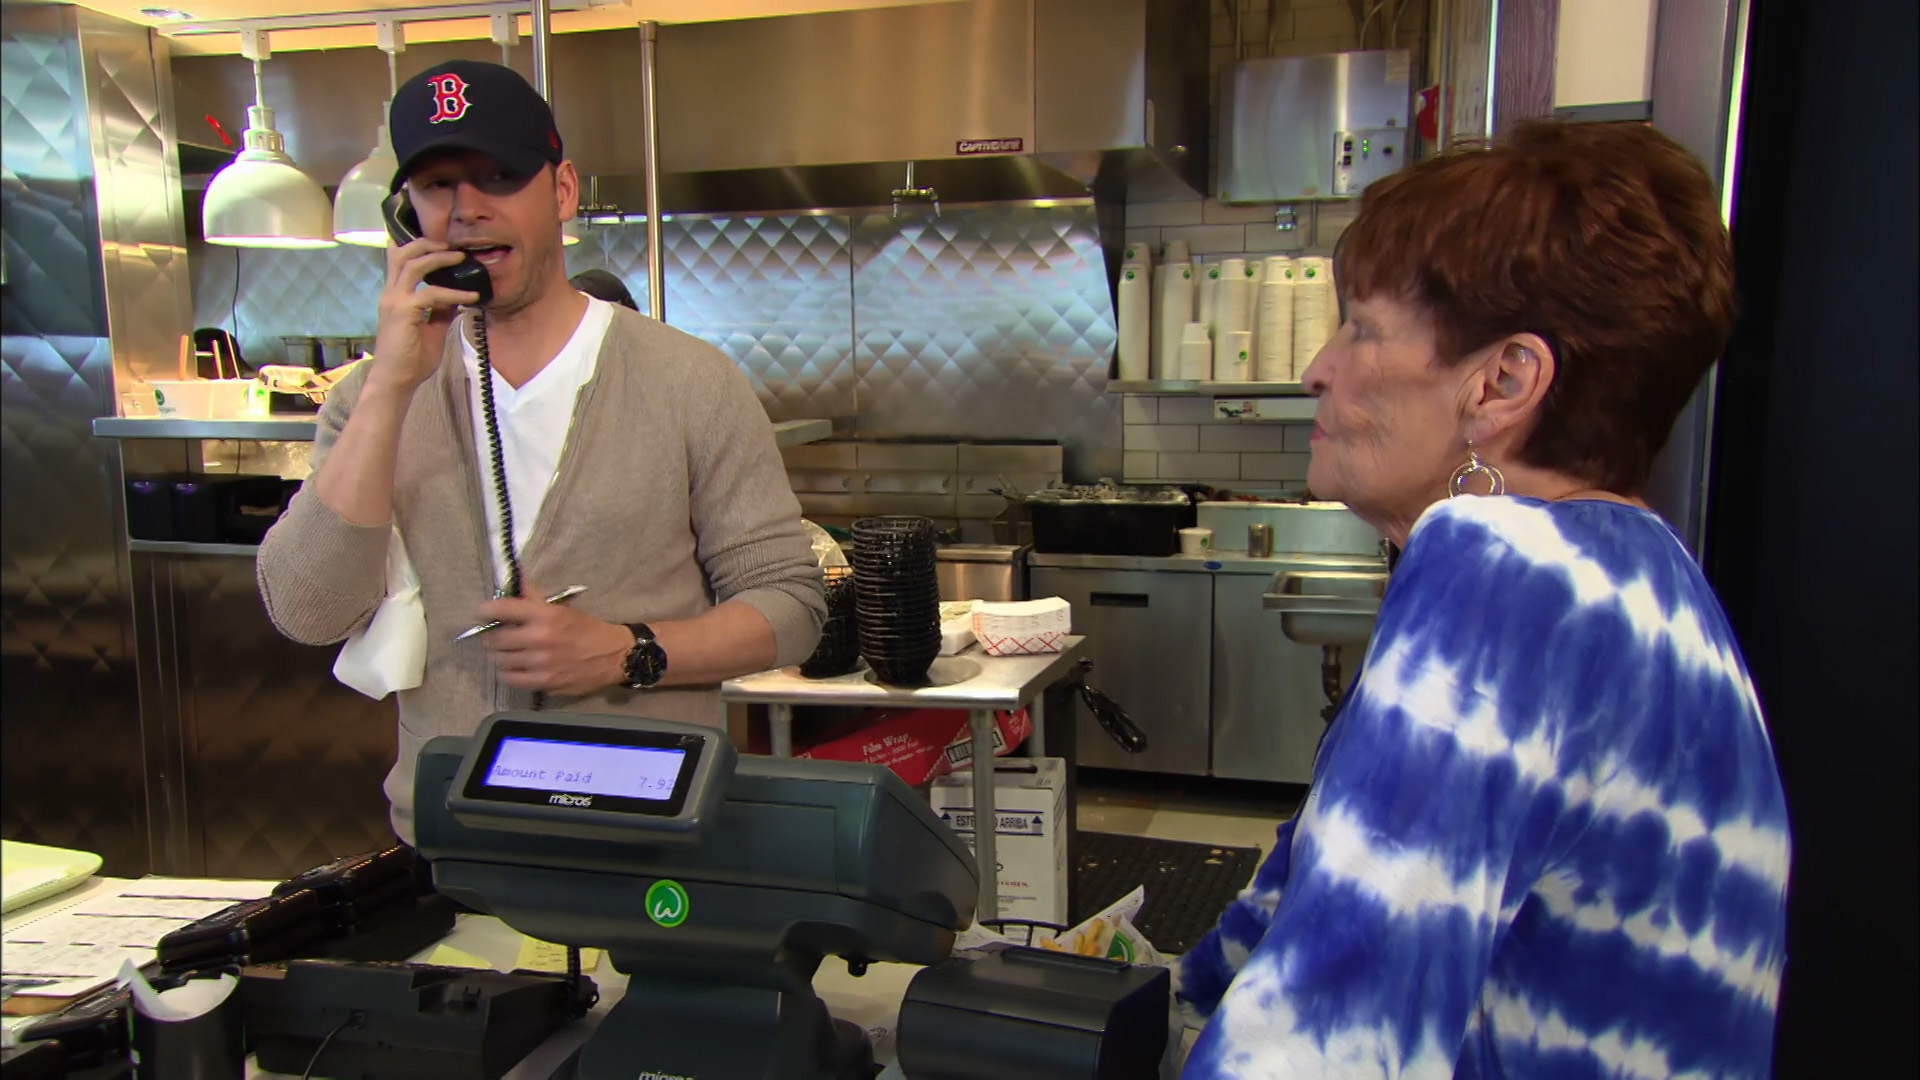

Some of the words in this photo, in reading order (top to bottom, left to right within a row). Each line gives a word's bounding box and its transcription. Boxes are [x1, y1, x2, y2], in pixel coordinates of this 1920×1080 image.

[427, 73, 473, 124] B
[494, 765, 547, 780] Amount
[554, 770, 593, 784] Paid
[548, 793, 593, 807] micros
[999, 816, 1028, 829] ARRIBA
